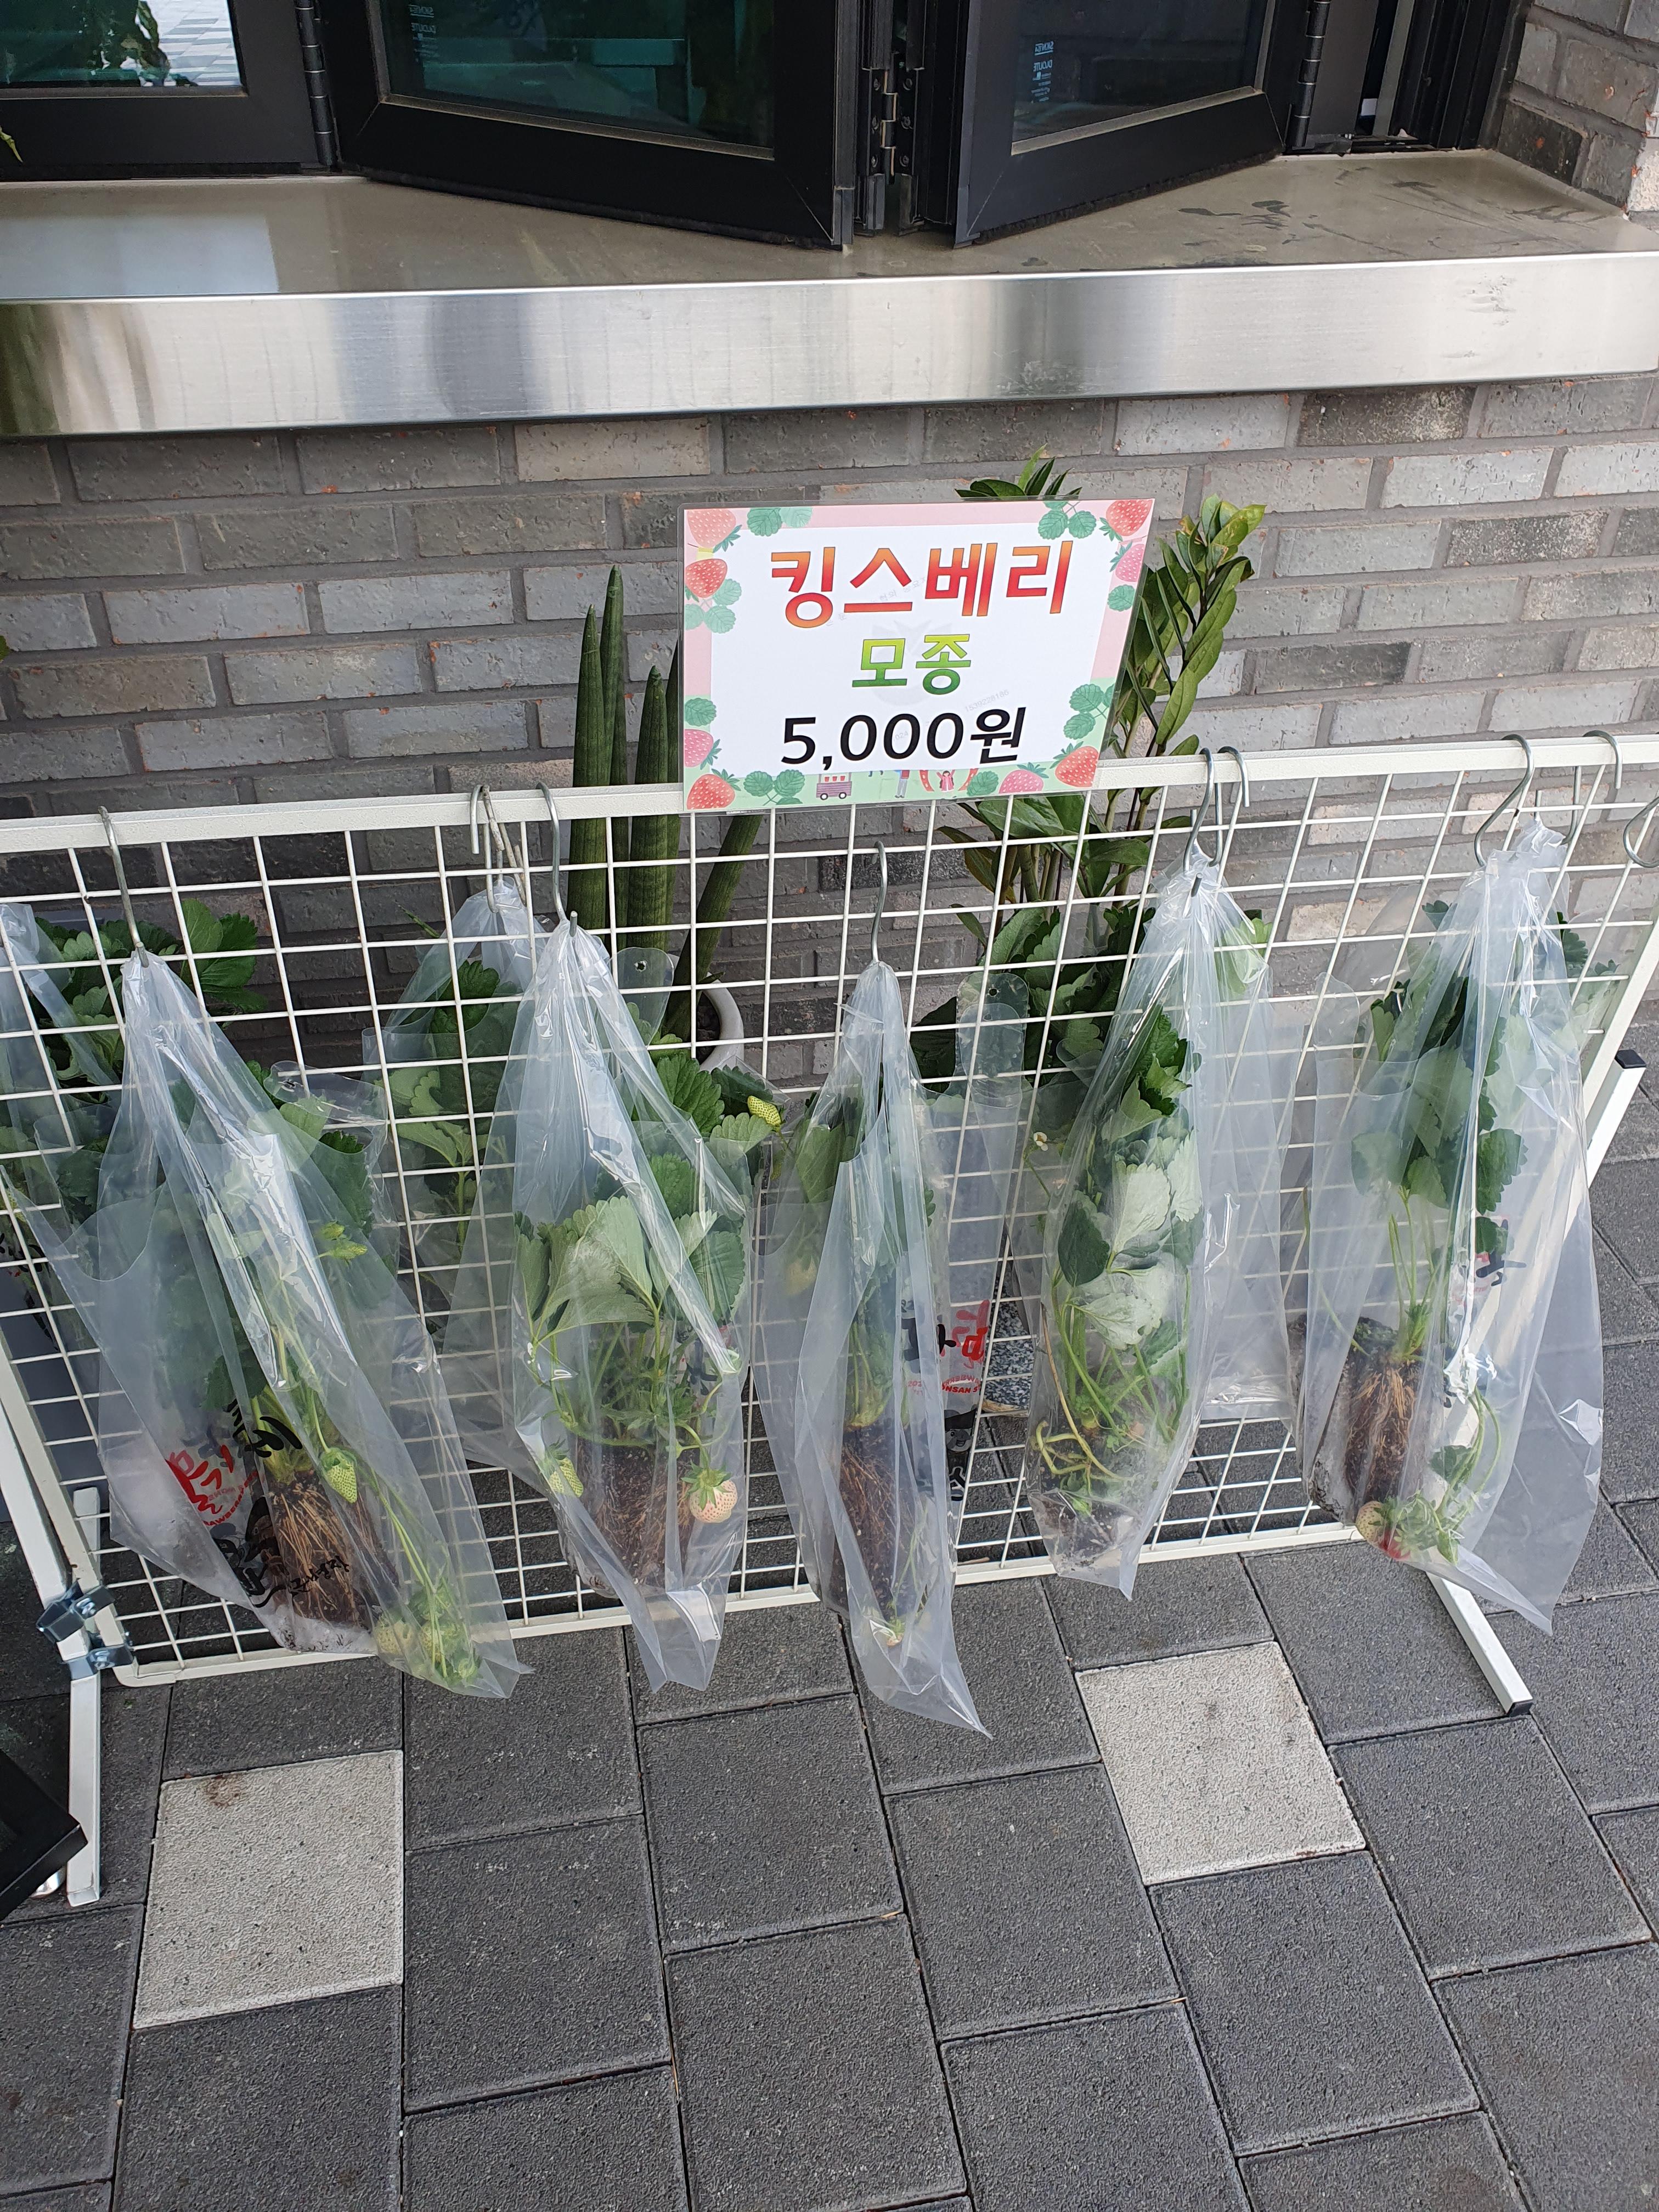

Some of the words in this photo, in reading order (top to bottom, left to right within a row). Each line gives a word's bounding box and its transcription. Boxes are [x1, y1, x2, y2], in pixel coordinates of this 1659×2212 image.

[770, 540, 1074, 629] 킹스베리
[851, 634, 972, 696] 모종
[780, 706, 1027, 771] 5,000원
